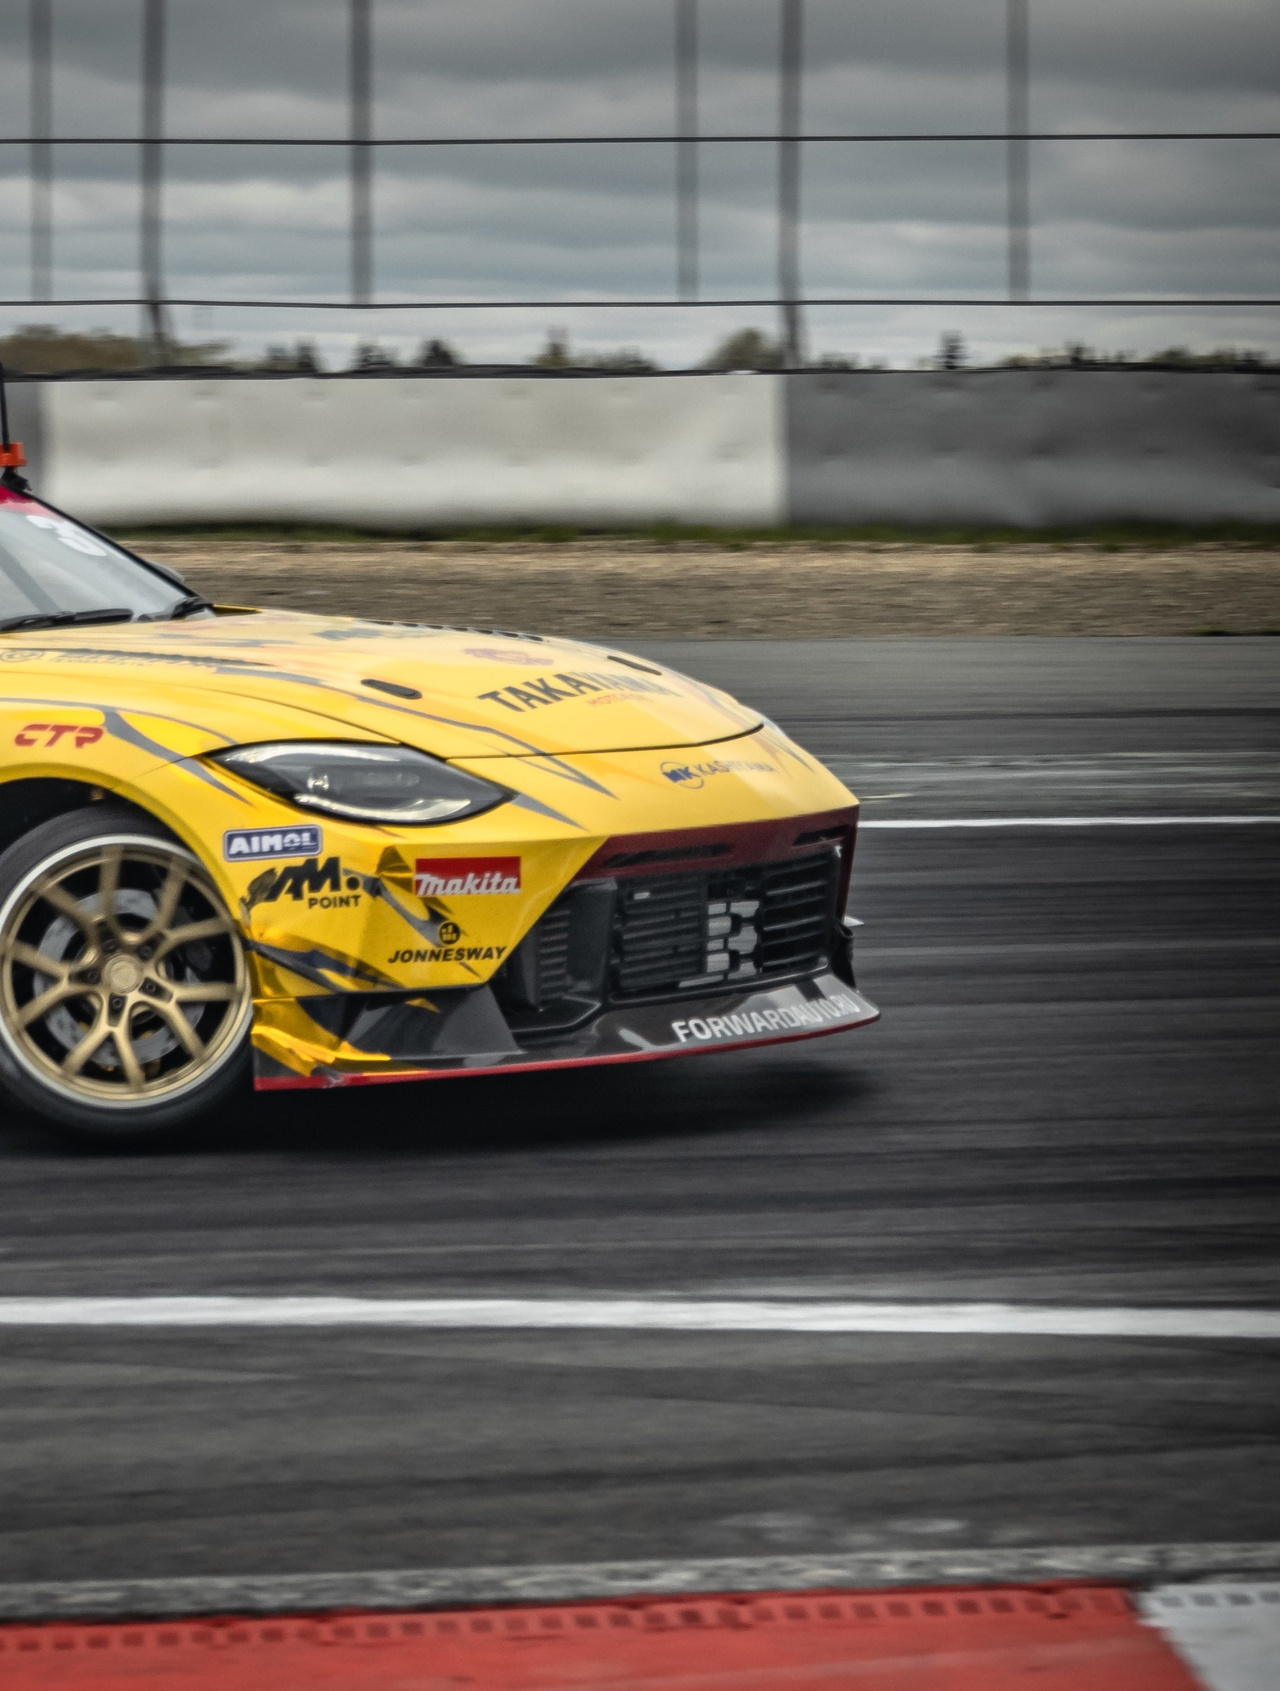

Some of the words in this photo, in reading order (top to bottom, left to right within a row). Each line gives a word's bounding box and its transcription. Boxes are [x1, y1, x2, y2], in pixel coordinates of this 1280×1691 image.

[228, 831, 318, 855] AIMOL
[308, 894, 362, 909] POINT
[387, 945, 508, 964] JONNESWAY
[671, 993, 861, 1043] FORWARDAUTO.RU
